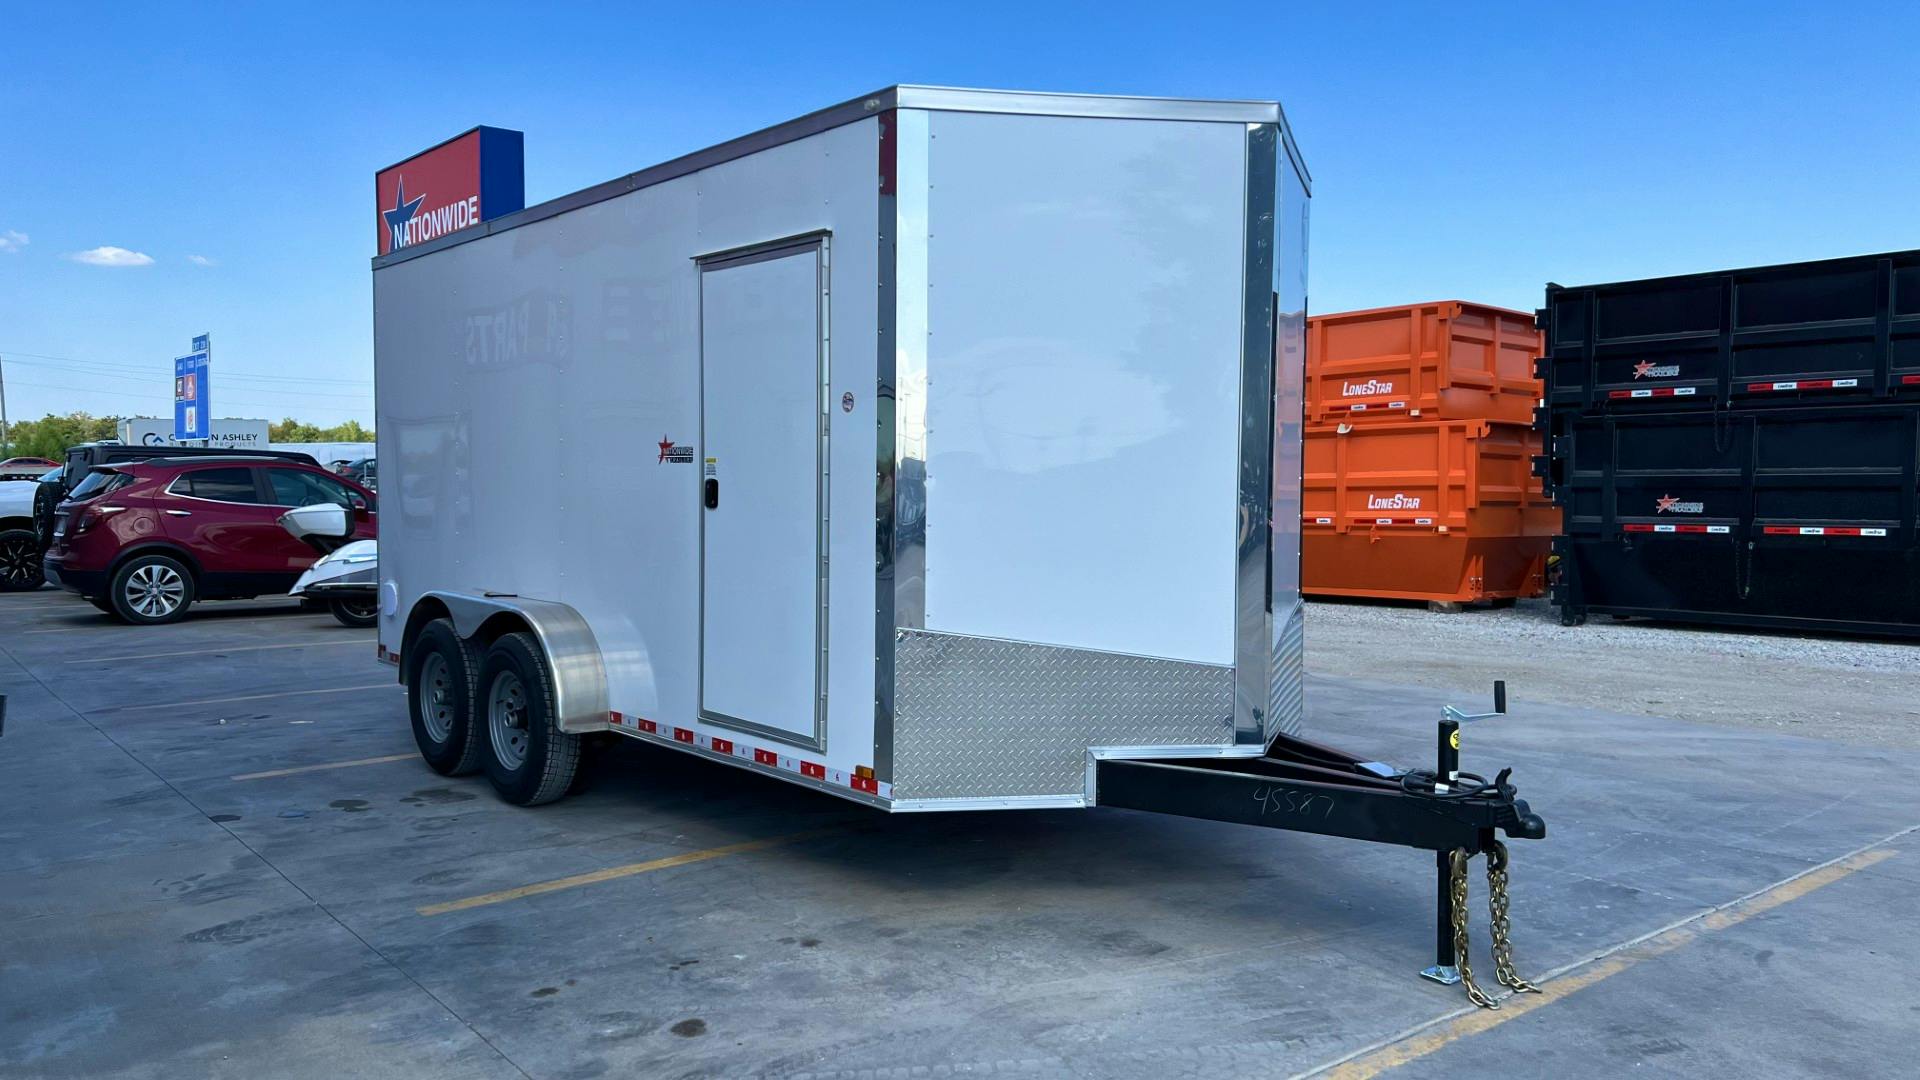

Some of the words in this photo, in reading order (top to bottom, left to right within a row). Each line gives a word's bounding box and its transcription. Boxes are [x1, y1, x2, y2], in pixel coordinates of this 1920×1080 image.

[394, 195, 479, 248] NATIONWIDE
[222, 433, 258, 441] ASHLEY
[1254, 786, 1334, 818] 45587
